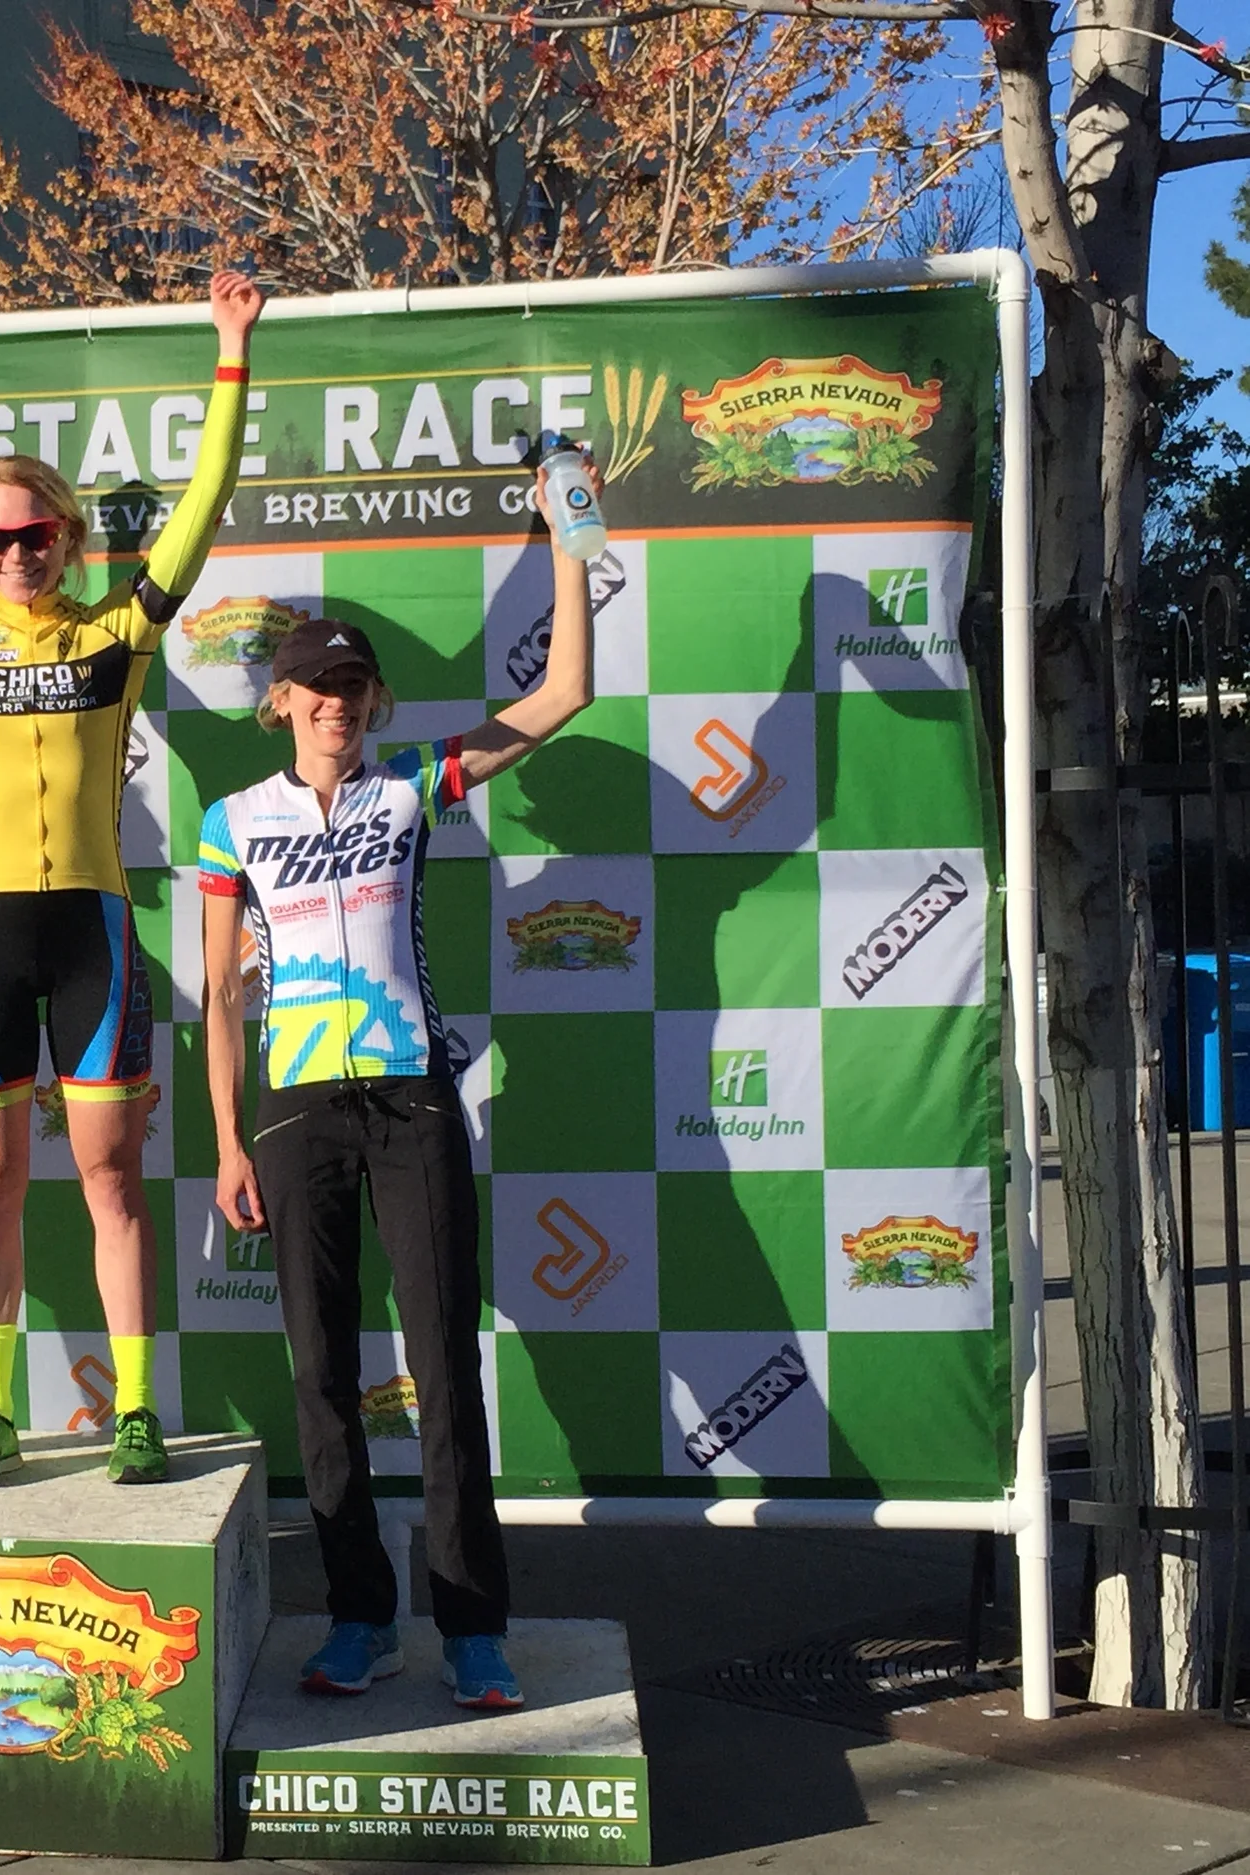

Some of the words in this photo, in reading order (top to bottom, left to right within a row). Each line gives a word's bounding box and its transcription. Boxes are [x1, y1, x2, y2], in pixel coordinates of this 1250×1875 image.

[720, 384, 804, 420] SIERRA
[810, 380, 902, 413] NEVADA
[324, 374, 592, 473] RACE
[263, 485, 474, 528] BREWING
[199, 613, 244, 632] SIERRA
[506, 549, 627, 693] MORN
[834, 634, 925, 661] Holiday
[39, 682, 76, 697] RACE
[269, 896, 327, 915] EQUATOR
[364, 887, 405, 905] TOYOTA
[526, 917, 572, 935] SIERRA
[842, 862, 969, 1000] MODERN
[675, 1114, 765, 1140] Holiday
[768, 1114, 805, 1136] Inn
[863, 1231, 908, 1251] SIERRA
[910, 1231, 959, 1250] NEVADA
[195, 1278, 278, 1304] Holiday
[685, 1344, 808, 1470] MODERN
[11, 1596, 141, 1654] NEVADA
[238, 1775, 359, 1813] CHICO
[380, 1777, 508, 1816] STAGE
[528, 1780, 638, 1819] RACE
[251, 1822, 320, 1834] PRESENTED
[325, 1823, 341, 1834] BY
[348, 1820, 412, 1837] SIERRA
[422, 1821, 496, 1838] NEVADA
[506, 1822, 591, 1840] BREWING
[599, 1828, 627, 1841] CO.
